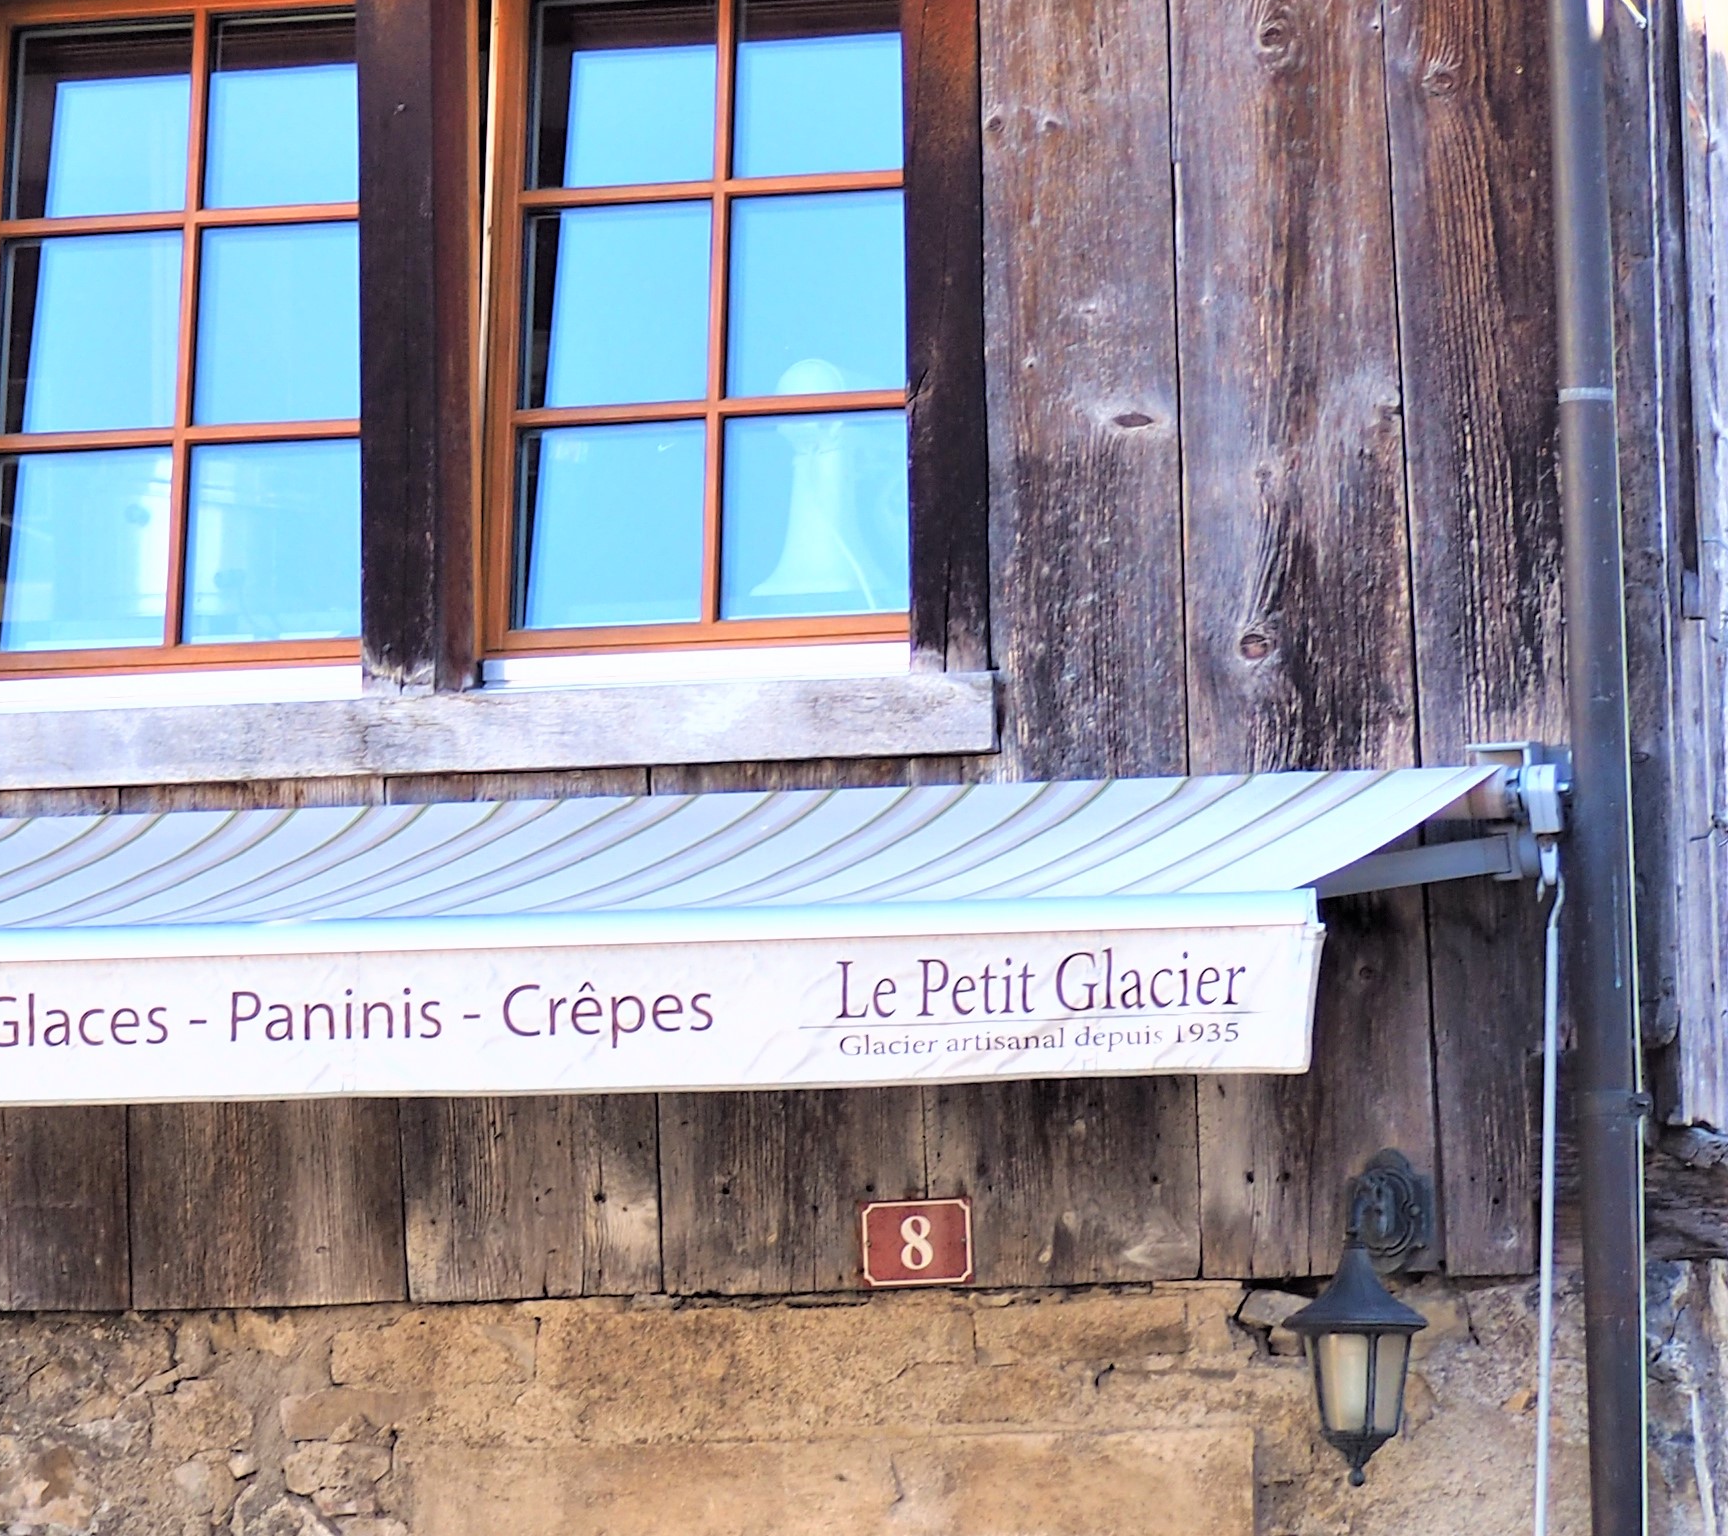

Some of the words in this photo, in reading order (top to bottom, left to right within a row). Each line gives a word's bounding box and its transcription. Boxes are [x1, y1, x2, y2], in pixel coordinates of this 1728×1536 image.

[835, 959, 897, 1019] Le
[917, 956, 1036, 1018] Petit
[1054, 947, 1246, 1014] Glacier
[229, 989, 443, 1043] Paninis
[501, 981, 714, 1048] Crêpes
[839, 1032, 938, 1058] Glacier
[945, 1027, 1066, 1053] artisanal
[1073, 1024, 1165, 1054] depuis
[1175, 1020, 1240, 1046] 1935
[900, 1215, 934, 1271] 8
